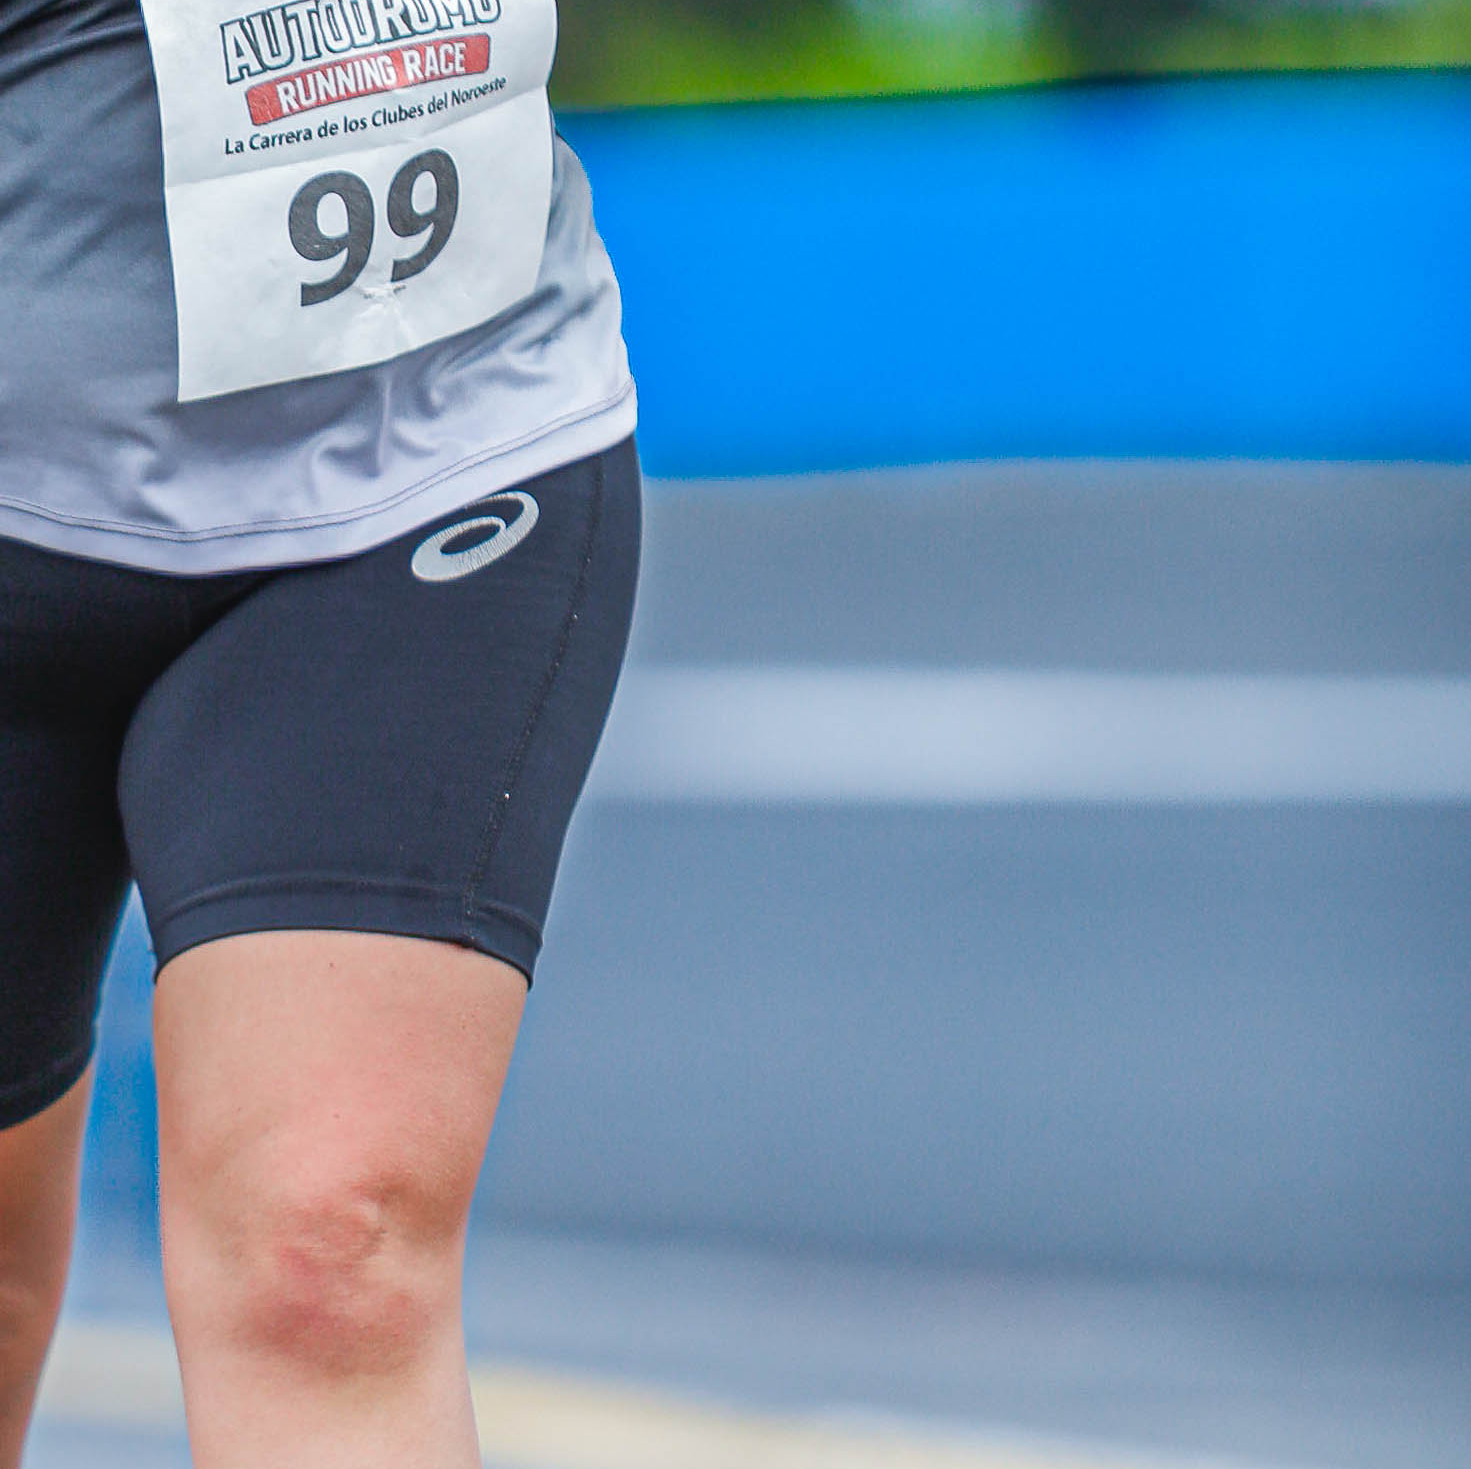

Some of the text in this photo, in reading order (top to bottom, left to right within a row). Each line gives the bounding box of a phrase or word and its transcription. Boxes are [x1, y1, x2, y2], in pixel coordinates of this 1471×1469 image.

[225, 76, 507, 155] La Carrera de los Clubes del Noroeste
[277, 41, 466, 115] RUNNING RACE
[288, 147, 460, 308] 99
